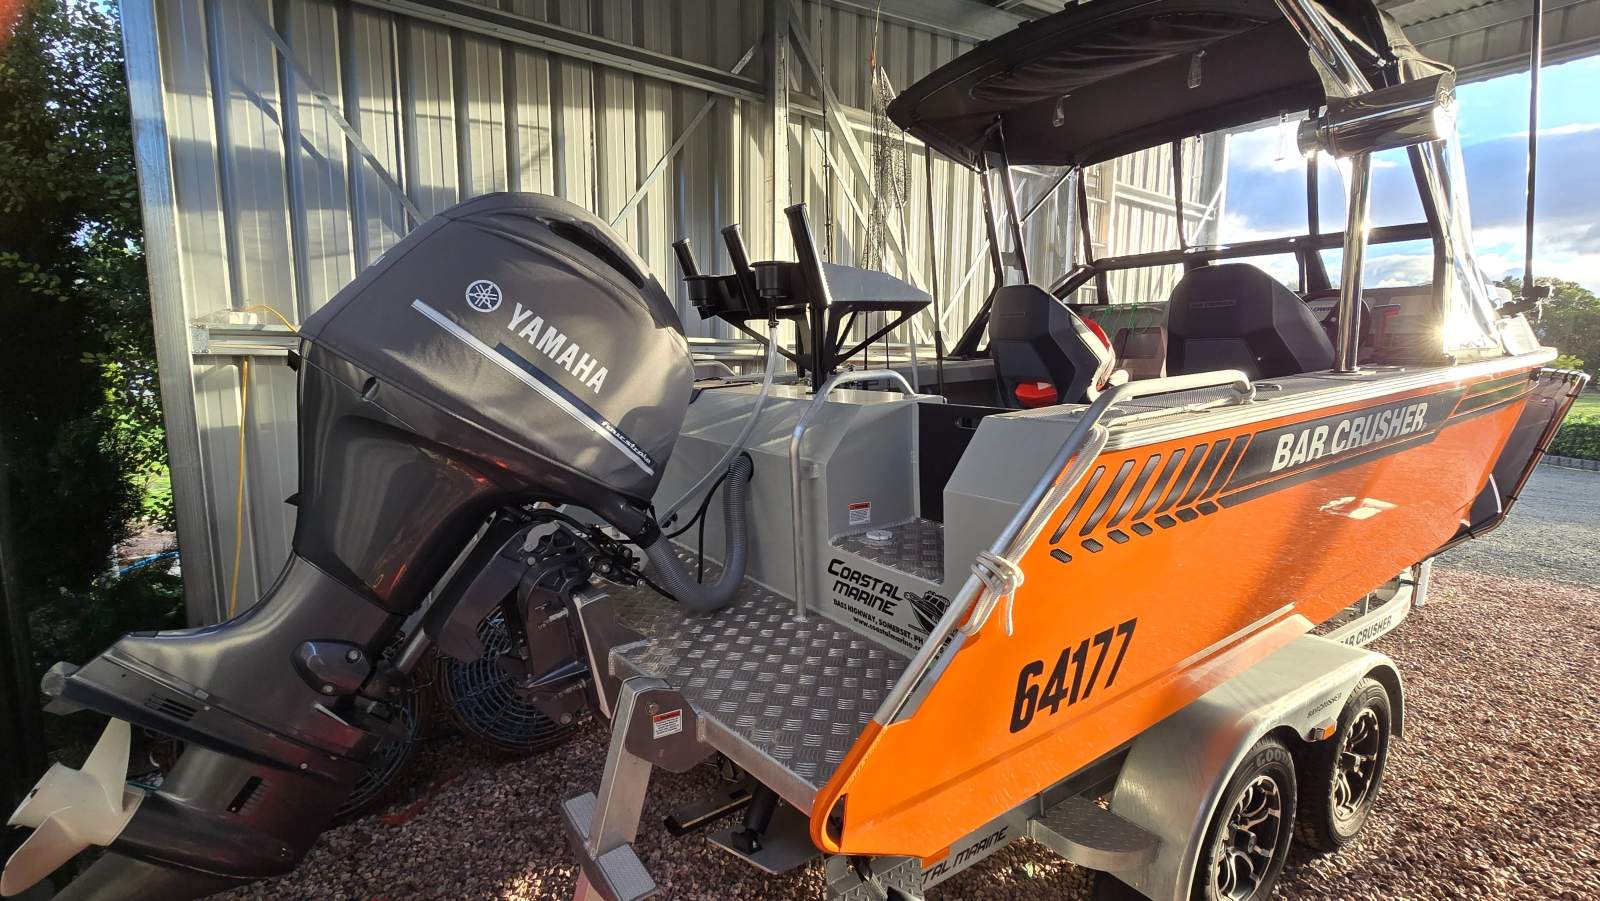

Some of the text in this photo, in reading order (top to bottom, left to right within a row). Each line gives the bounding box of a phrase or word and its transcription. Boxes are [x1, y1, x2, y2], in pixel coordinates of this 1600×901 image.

[506, 302, 609, 395] YAMAHA
[1270, 402, 1428, 473] BAR CRUSHER
[828, 558, 903, 602] COASTAL
[833, 580, 898, 616] MARINE
[833, 599, 847, 610] BASS
[1356, 615, 1392, 645] CRUSHER
[1009, 616, 1138, 734] 64177
[953, 825, 1009, 869] MARINE
